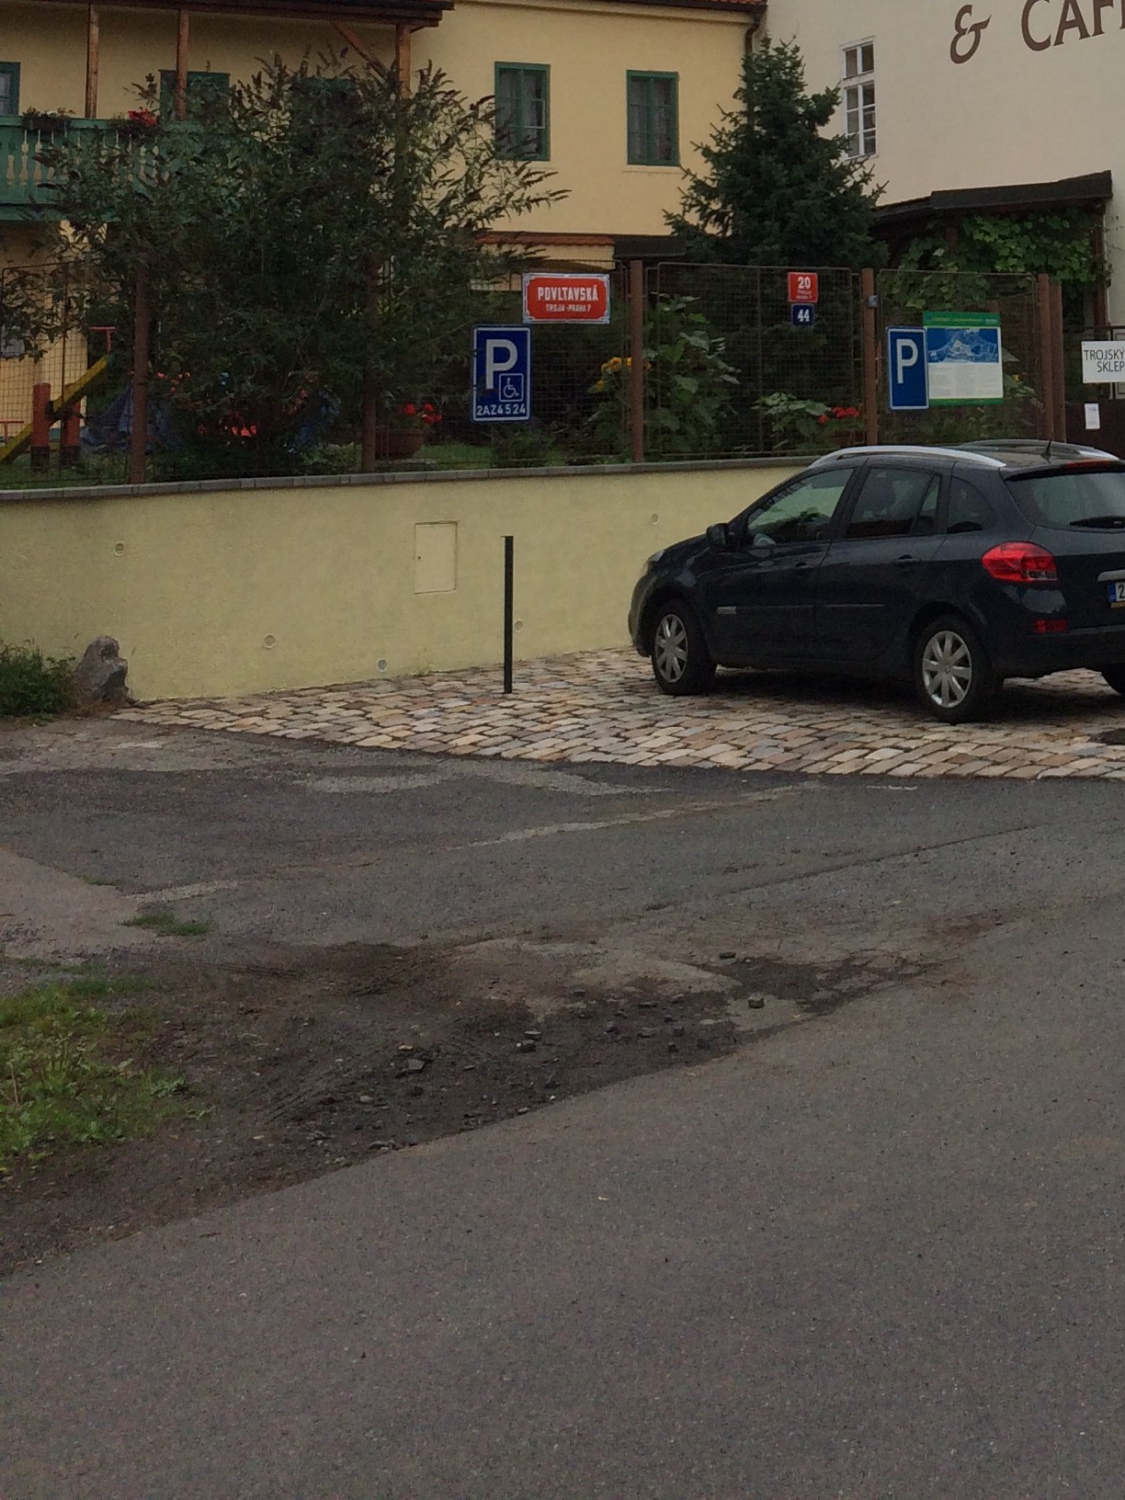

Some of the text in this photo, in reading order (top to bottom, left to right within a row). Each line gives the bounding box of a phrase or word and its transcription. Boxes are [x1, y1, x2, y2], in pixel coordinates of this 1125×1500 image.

[950, 4, 992, 65] &
[797, 275, 812, 290] 20
[537, 283, 599, 301] POVLTAVSKÁ
[797, 308, 811, 323] 44
[896, 338, 919, 385] P
[1083, 346, 1125, 361] TROJSKÝ
[485, 338, 519, 390] P
[1096, 360, 1125, 373] SKLEP
